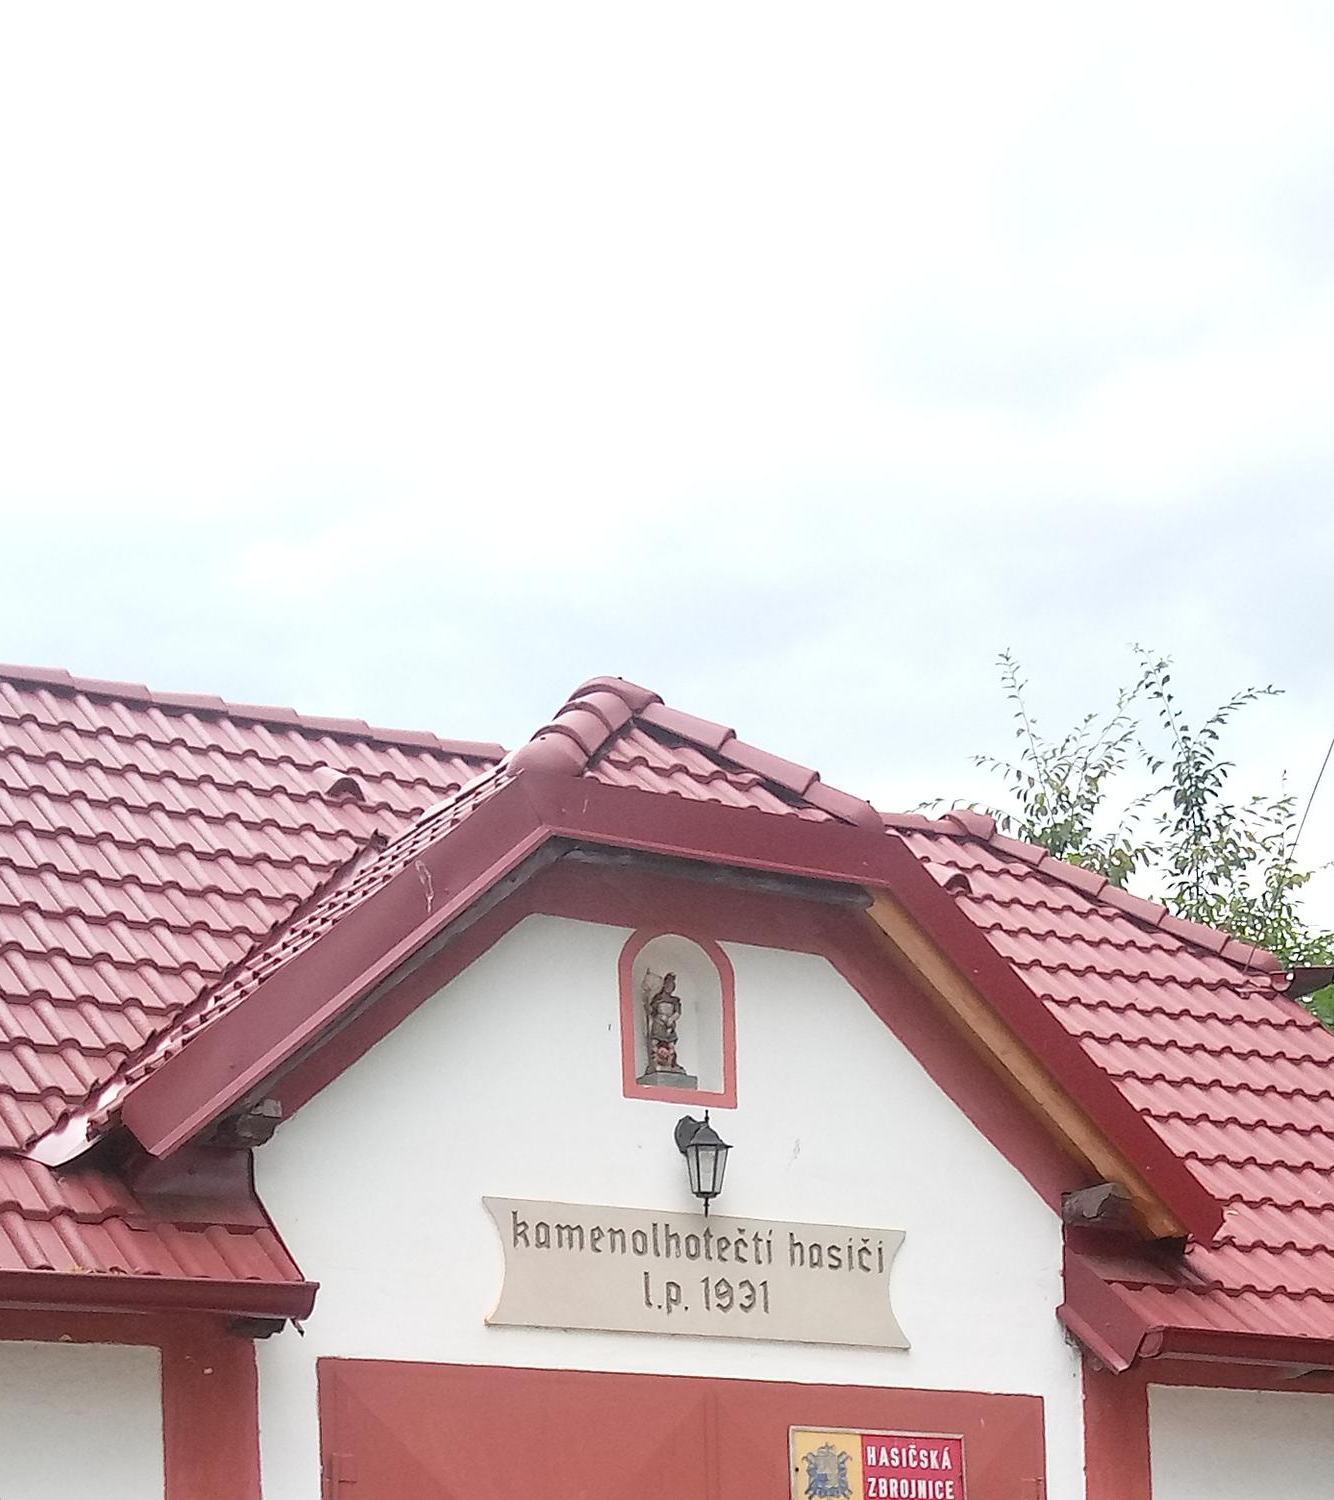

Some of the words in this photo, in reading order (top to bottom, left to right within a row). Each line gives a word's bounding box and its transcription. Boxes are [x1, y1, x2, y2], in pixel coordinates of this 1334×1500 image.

[789, 1231, 885, 1274] hasiči
[700, 1276, 770, 1314] 1931
[867, 1444, 953, 1471] HASIČSKÁ
[868, 1477, 955, 1500] ZBROJNICE
